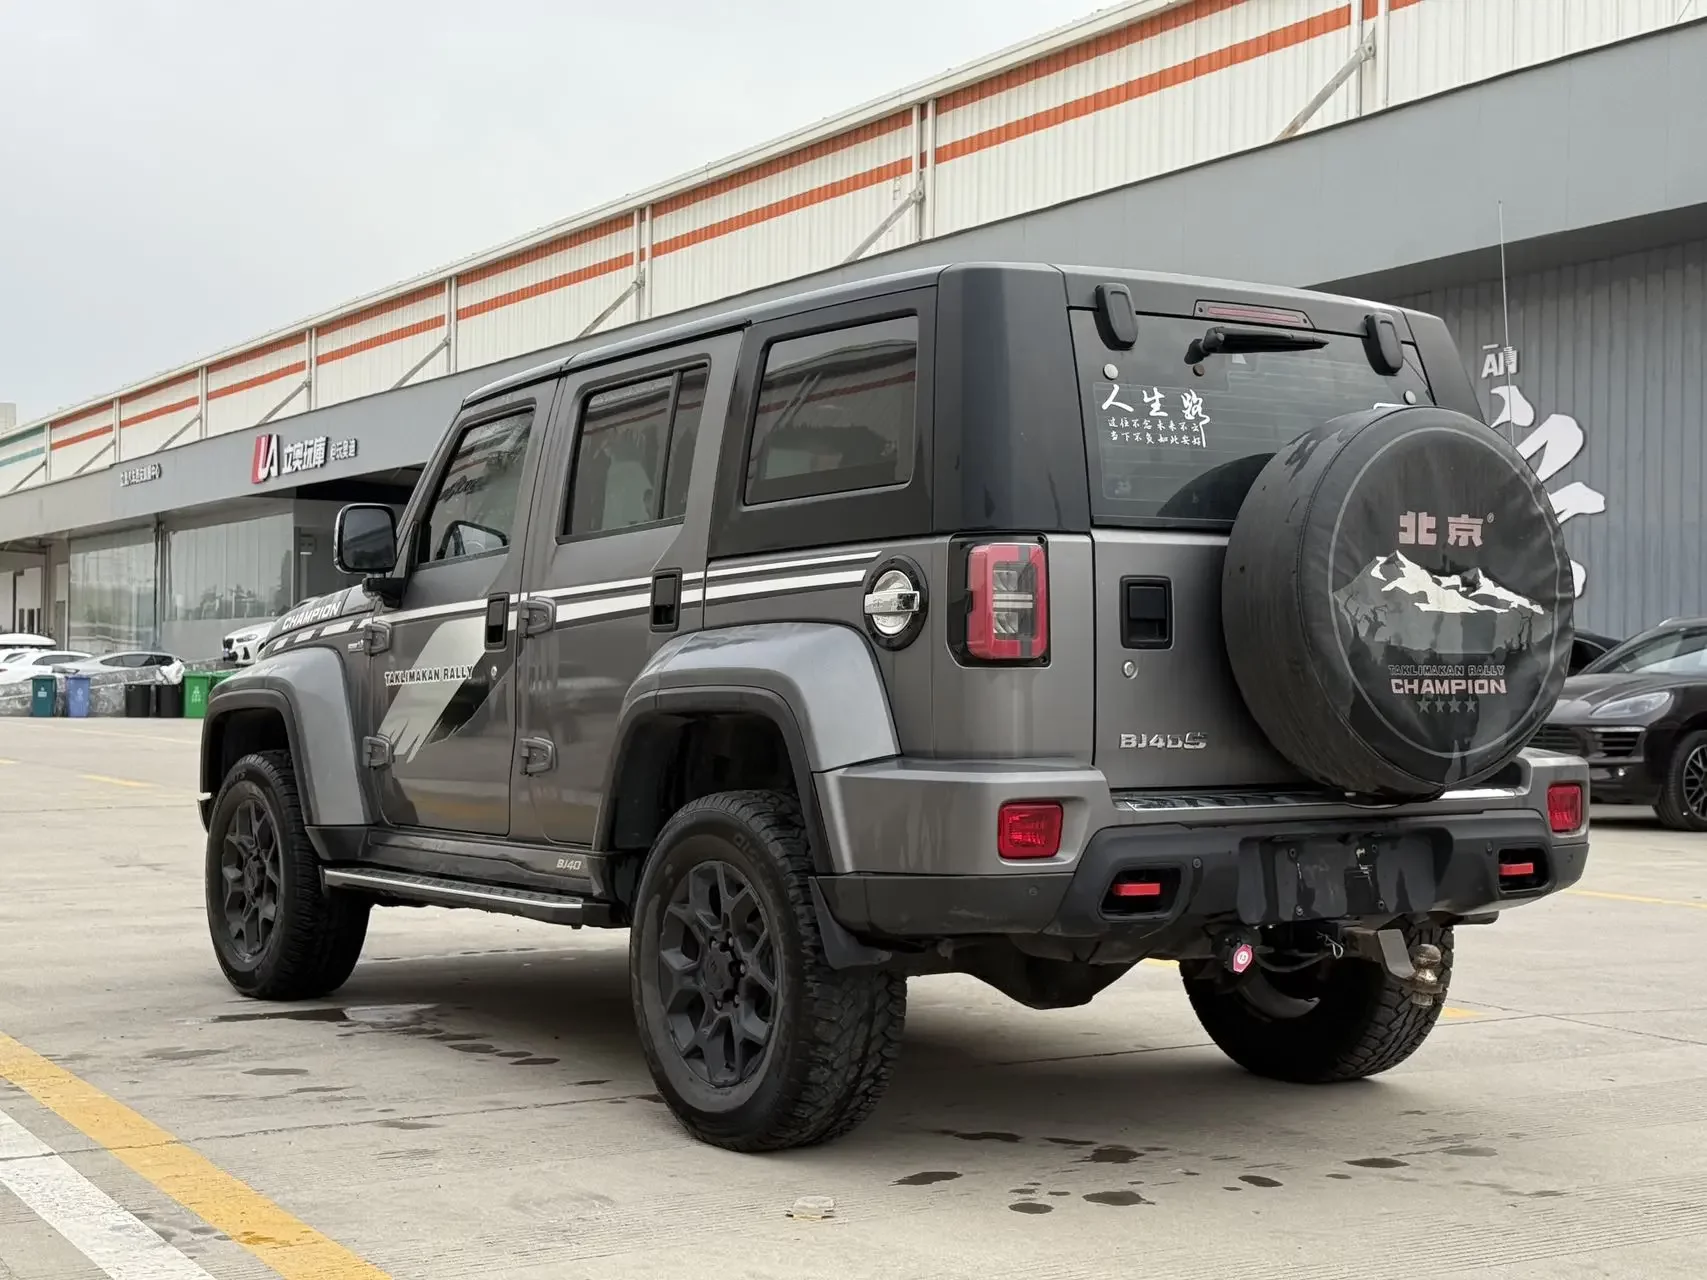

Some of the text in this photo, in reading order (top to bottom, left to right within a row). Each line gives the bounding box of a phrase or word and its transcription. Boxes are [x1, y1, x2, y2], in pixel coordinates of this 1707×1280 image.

[1101, 383, 1211, 448] 人生路
[281, 599, 342, 631] CHAMPION
[384, 664, 474, 686] TAKLIMAKAN RALLY
[1388, 663, 1506, 677] TAKLIMAKAN RALLY
[1391, 678, 1507, 695] CHAMPION
[556, 858, 582, 870] BJ40
